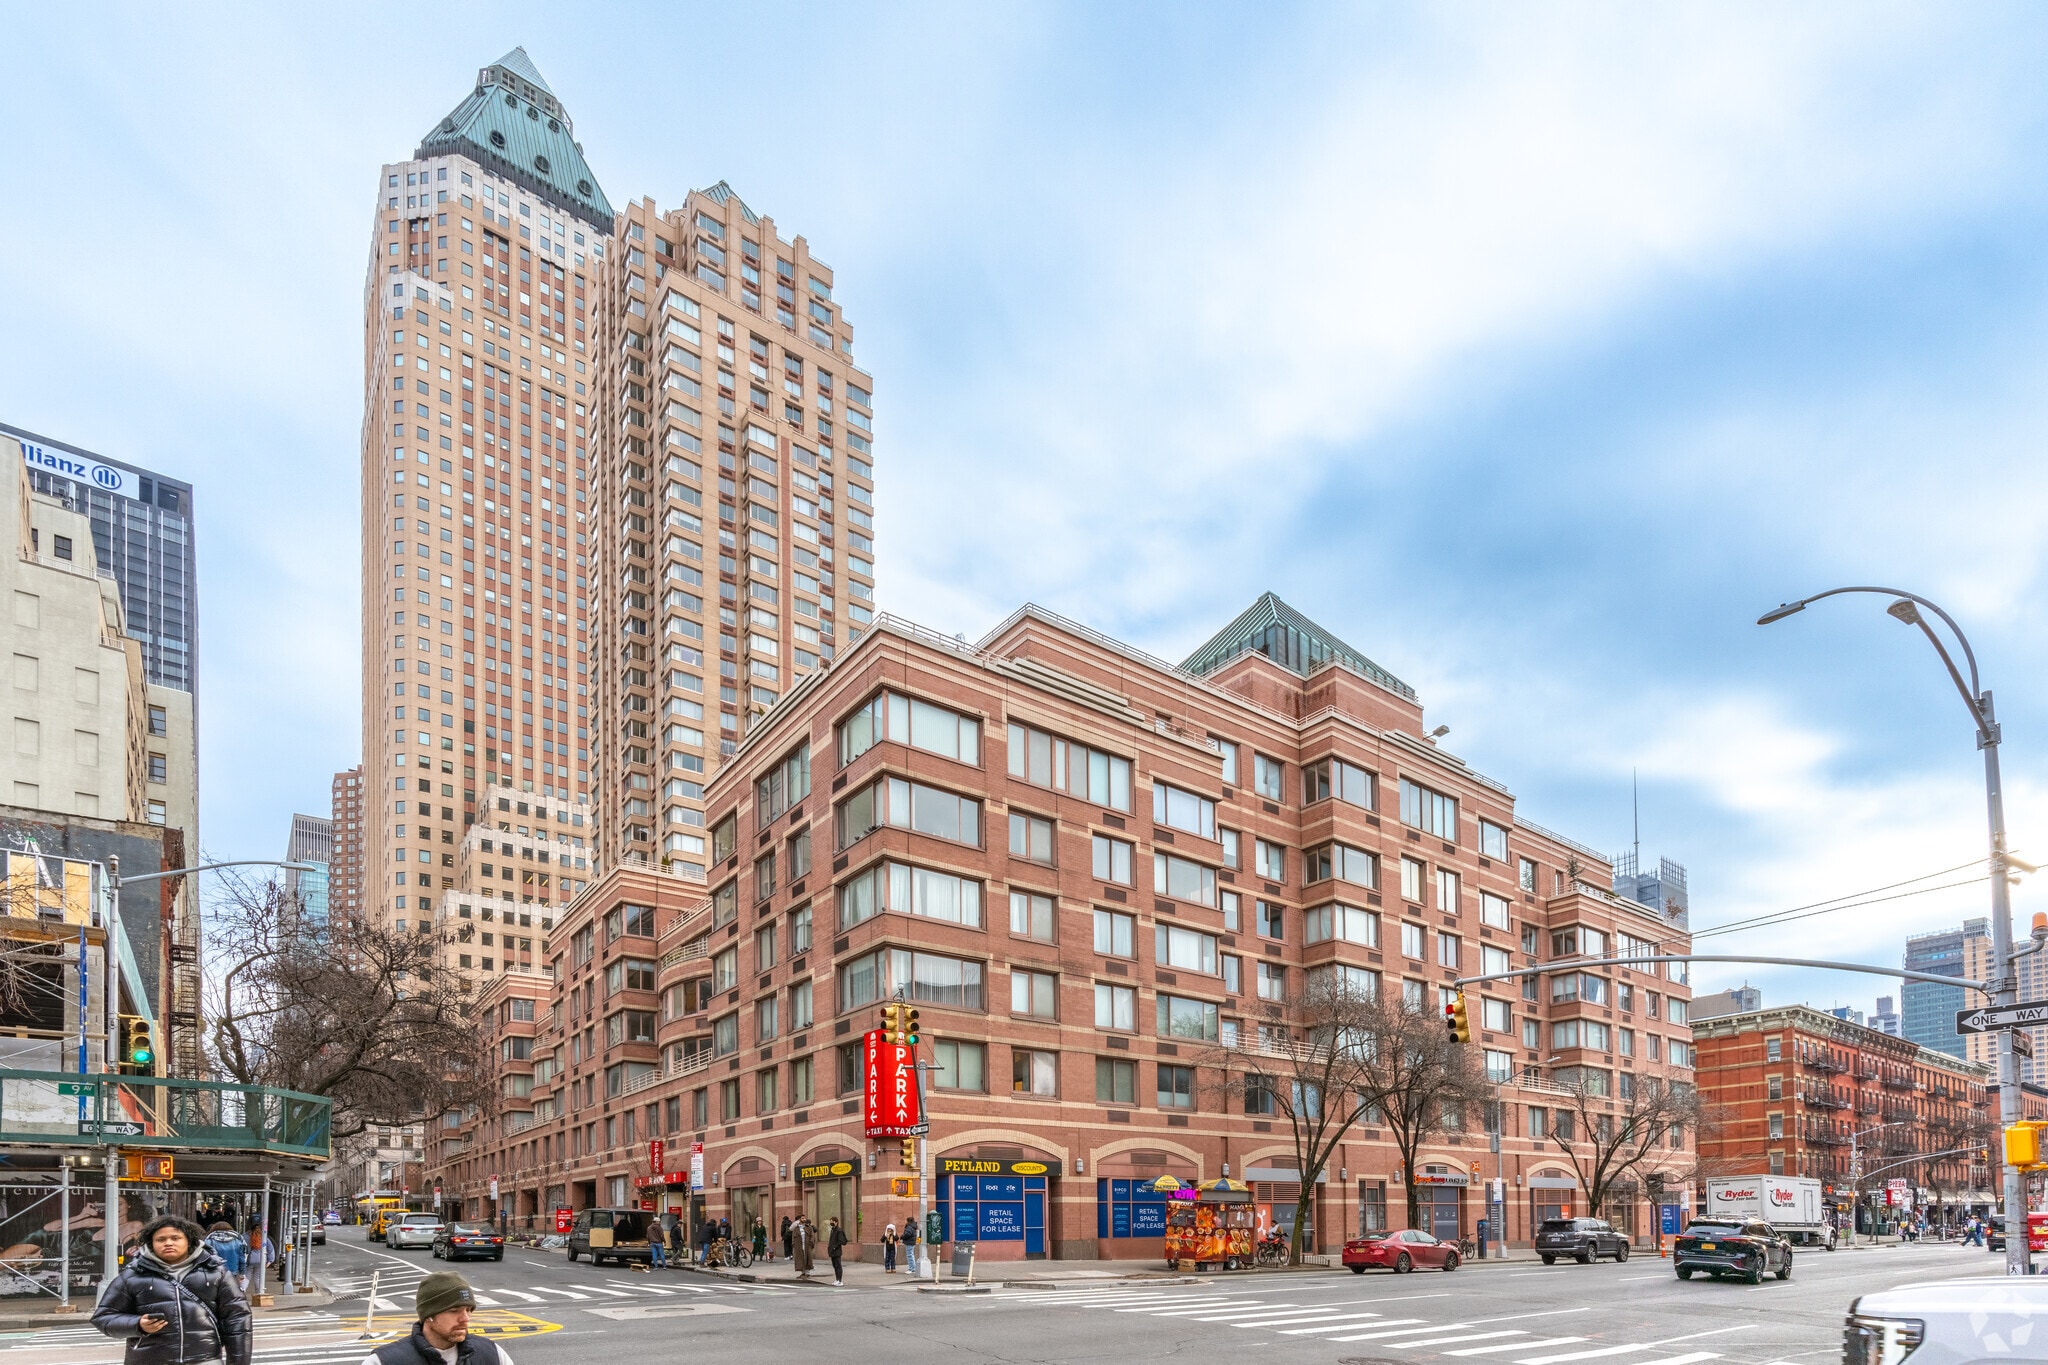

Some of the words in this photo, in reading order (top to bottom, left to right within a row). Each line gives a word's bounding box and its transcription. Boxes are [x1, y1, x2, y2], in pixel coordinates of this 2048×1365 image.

[20, 443, 86, 478] llianz
[1972, 1014, 1998, 1026] ONE
[2016, 1008, 2044, 1020] WAY
[869, 1048, 878, 1108] PARK
[895, 1047, 908, 1108] PARK
[71, 1085, 80, 1095] 9
[870, 1126, 883, 1135] TAXI
[894, 1127, 911, 1135] TAX
[160, 1161, 170, 1175] 12
[801, 1165, 830, 1178] PETLAND
[945, 1160, 1001, 1173] PETLAND
[2, 1184, 51, 1196] leur
[71, 1184, 94, 1196] du
[1725, 1190, 1755, 1199] Ryder
[1775, 1188, 1793, 1203] Ryder
[989, 1209, 1013, 1217] RETAIL
[558, 1220, 565, 1229] 9
[989, 1217, 1013, 1225] SPACE
[981, 1225, 997, 1233] FOR
[998, 1225, 1021, 1233] LEASE
